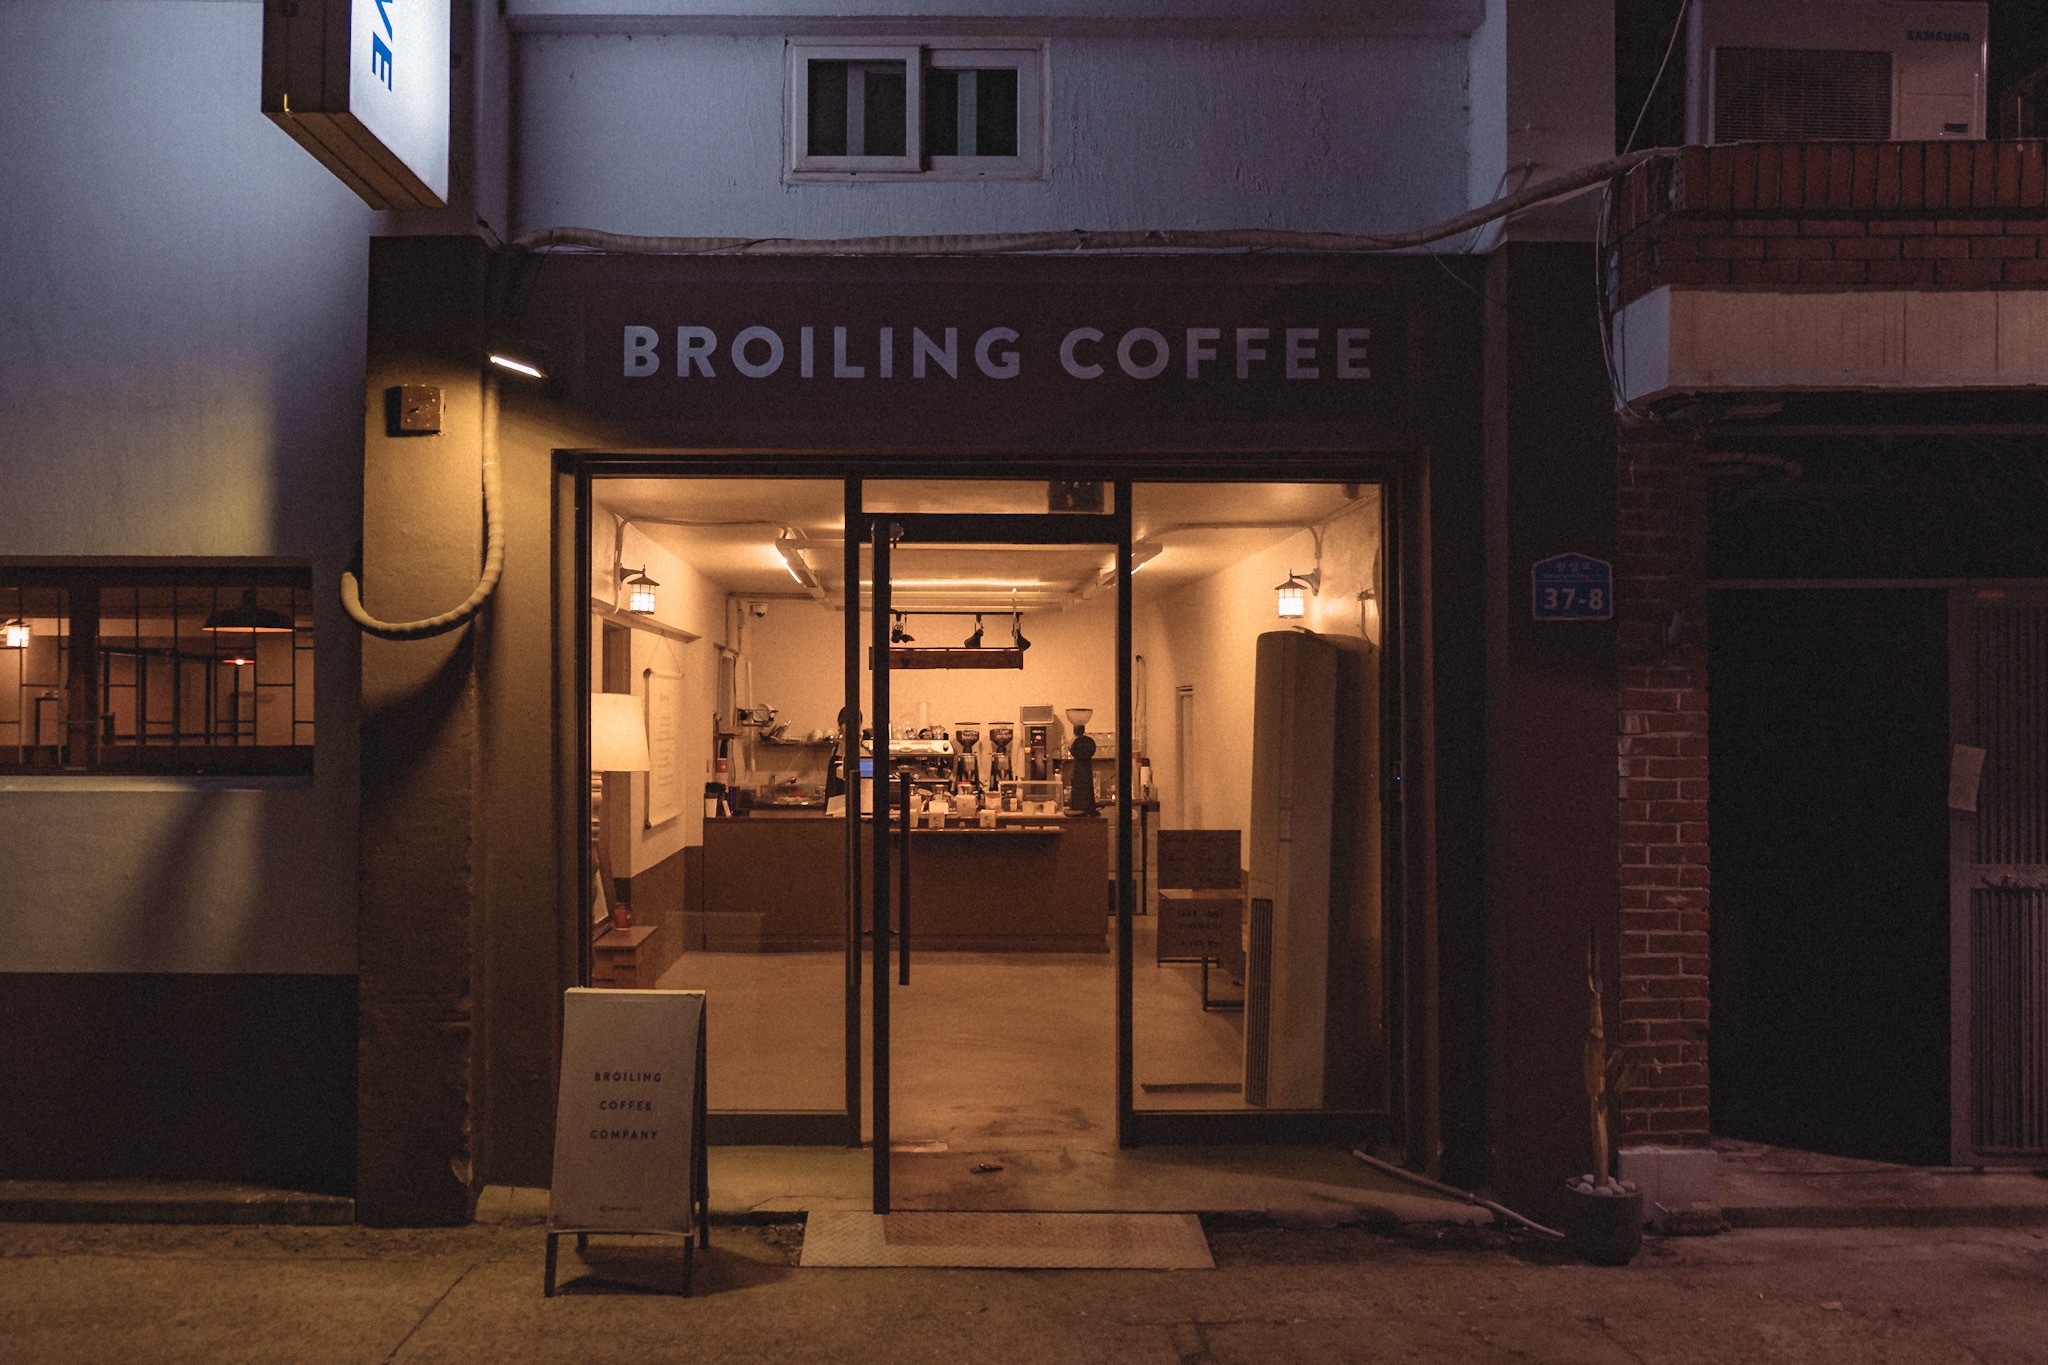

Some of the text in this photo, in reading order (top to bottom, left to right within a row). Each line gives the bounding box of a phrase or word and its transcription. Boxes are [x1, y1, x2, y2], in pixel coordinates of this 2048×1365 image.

[623, 324, 1371, 381] BROILING COFFEE
[1544, 588, 1604, 610] 37-8
[594, 1072, 662, 1082] BROILING
[599, 1100, 653, 1111] COFFEE
[590, 1129, 658, 1140] COMPANY
